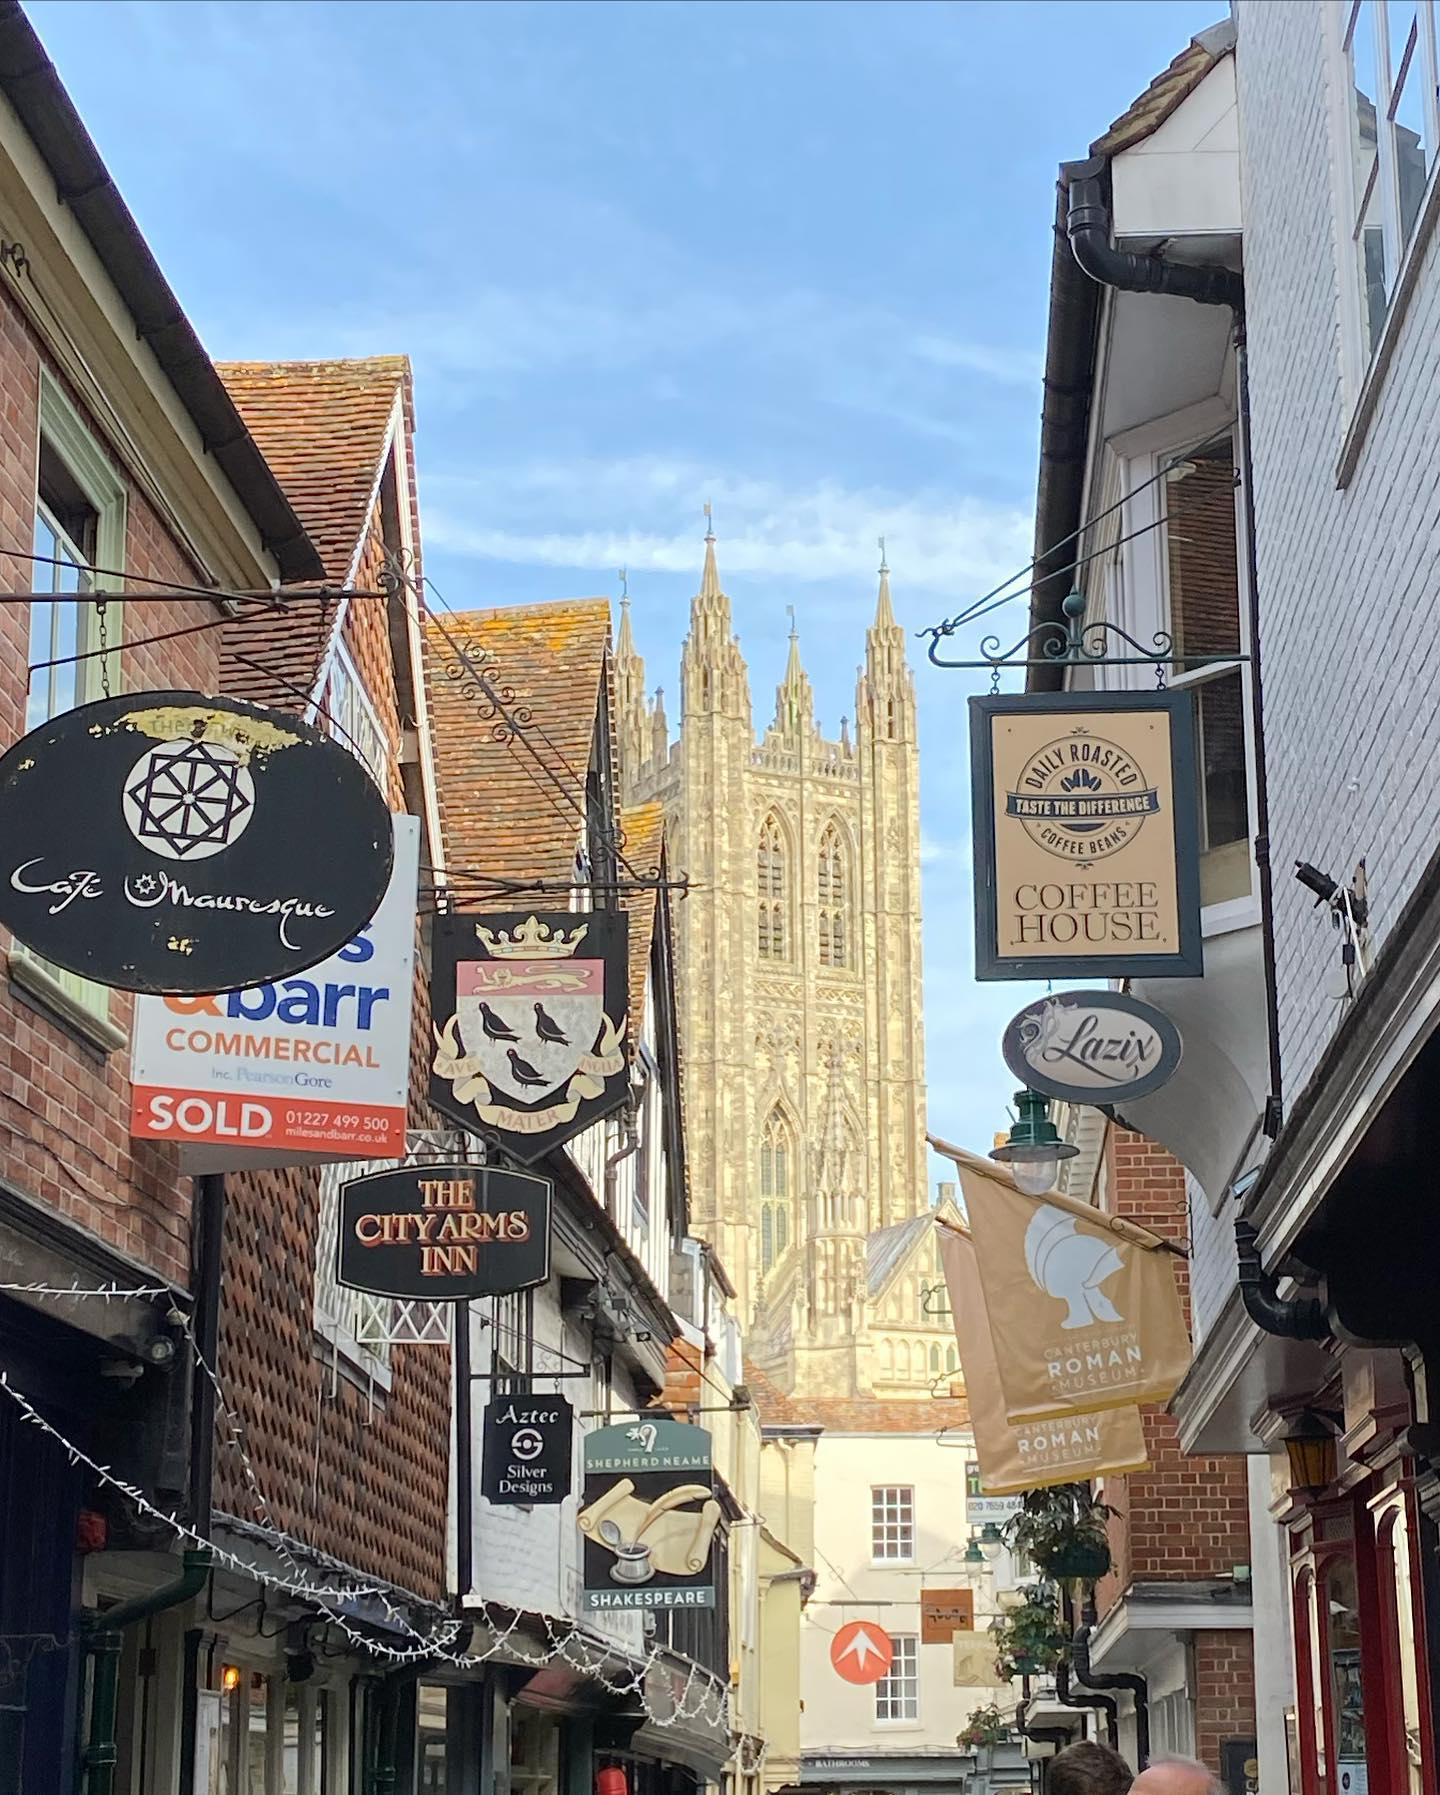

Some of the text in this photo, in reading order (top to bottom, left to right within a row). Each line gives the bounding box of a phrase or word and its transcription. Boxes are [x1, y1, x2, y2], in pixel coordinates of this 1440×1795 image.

[1025, 743, 1137, 789] DAILY ROASTED
[1016, 796, 1150, 815] TASTE THE DIFFERENCE
[1040, 826, 1127, 855] COFFEE BEANS
[1014, 882, 1159, 911] COFFEE
[1013, 911, 1161, 944] HOUSE
[165, 1027, 381, 1069] COMMERCIAL
[148, 1095, 273, 1138] SOLD
[285, 1110, 389, 1131] 01227 499 500
[285, 1127, 388, 1144] milesandbarr.co.uk
[418, 1179, 476, 1211] THE
[355, 1210, 531, 1247] CITY ARMS
[420, 1245, 478, 1277] INN
[1048, 1345, 1142, 1378] ROMAN
[495, 1404, 559, 1424] Aztec
[1017, 1426, 1099, 1453] ROMAN
[507, 1464, 547, 1479] Silver
[586, 1455, 710, 1469] SHEPHERD NEAME
[499, 1479, 554, 1497] Designs
[590, 1591, 705, 1607] SHAKESPEARE
